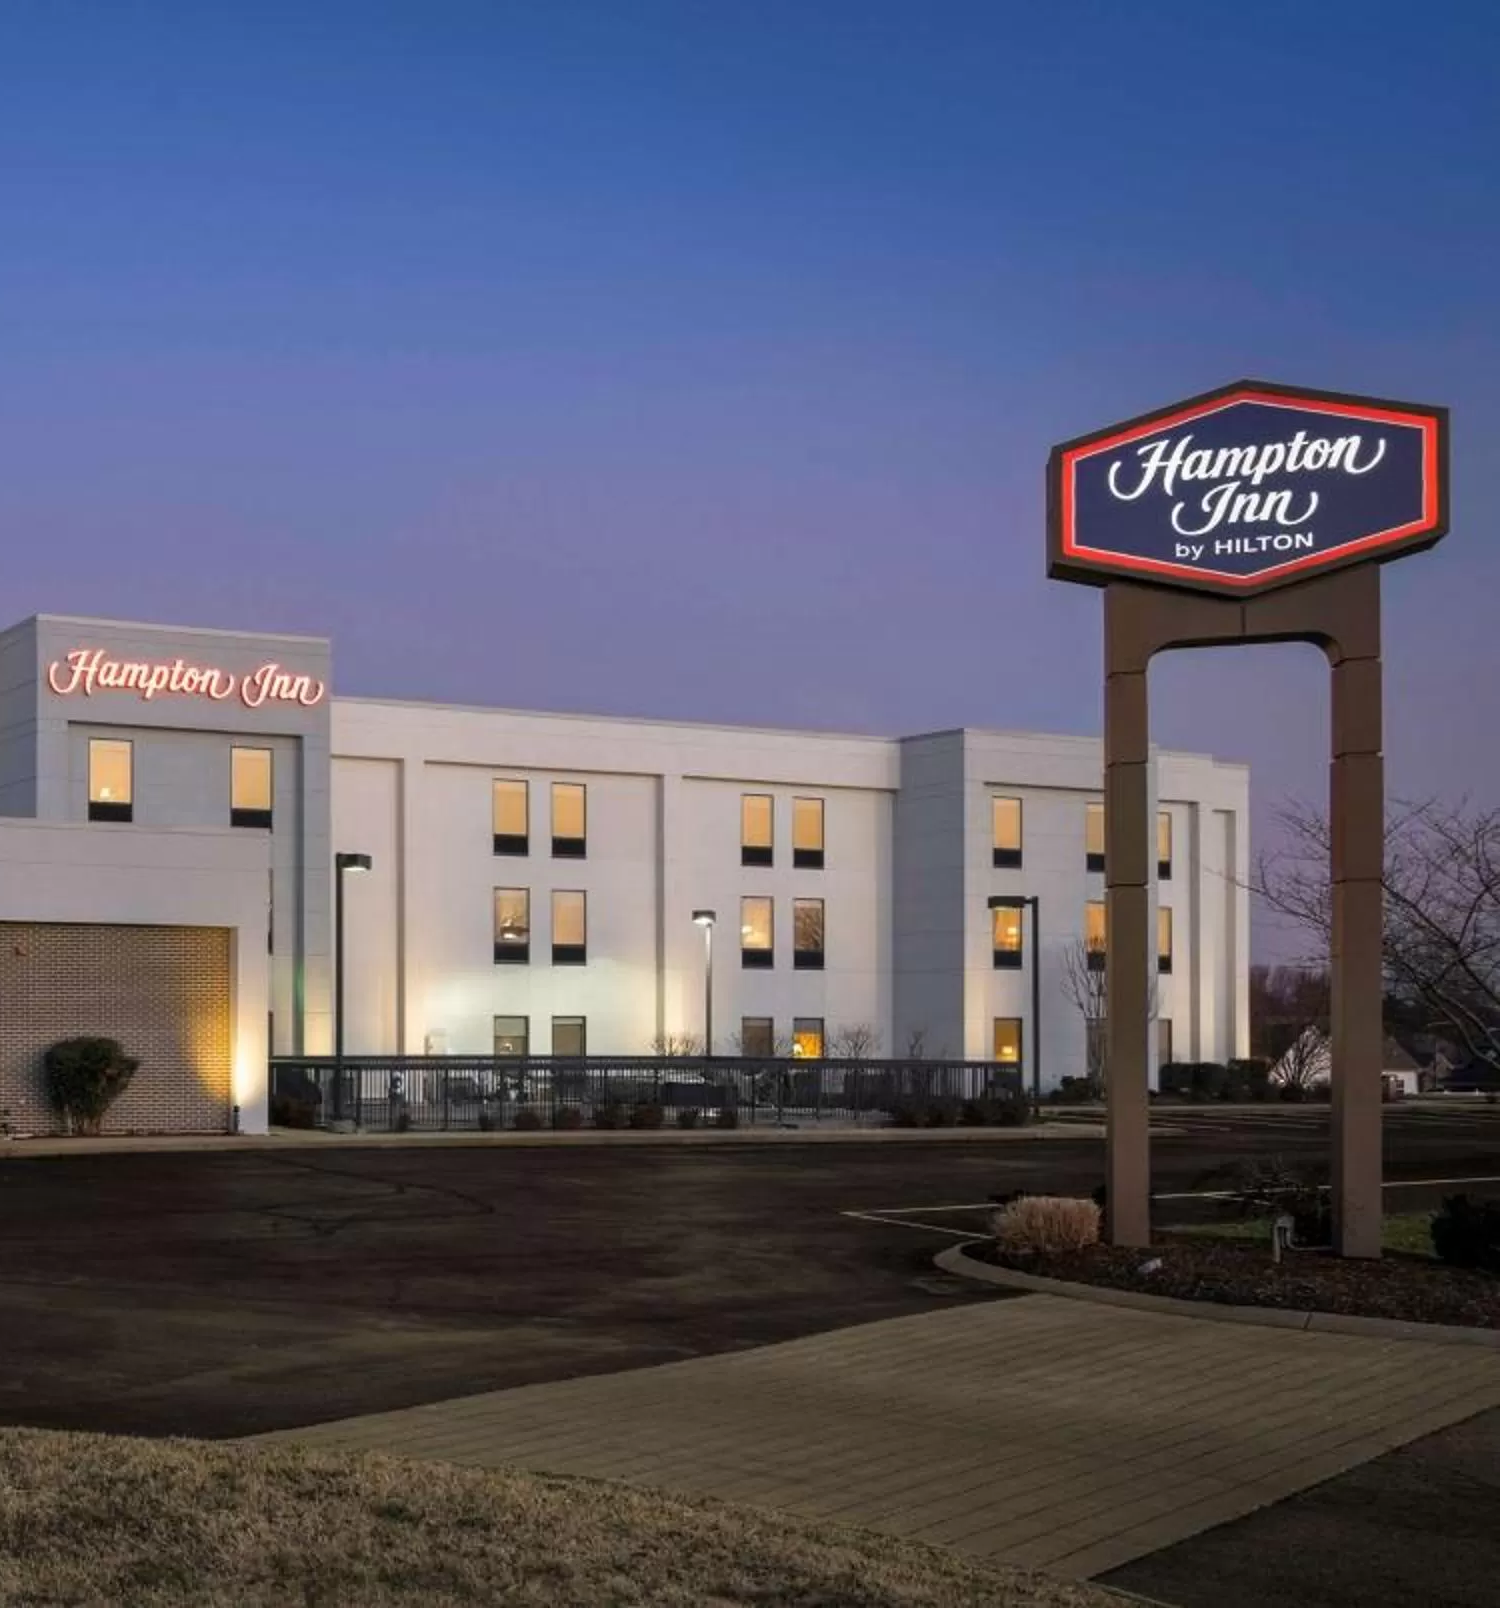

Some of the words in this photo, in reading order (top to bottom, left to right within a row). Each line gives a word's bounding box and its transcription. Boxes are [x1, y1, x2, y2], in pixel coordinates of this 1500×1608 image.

[1107, 430, 1387, 500] Hampton
[1170, 480, 1320, 536] Inn
[1174, 542, 1205, 561] by
[1214, 531, 1315, 555] HILTON
[49, 648, 235, 699] Hampton
[241, 663, 325, 708] Inn
